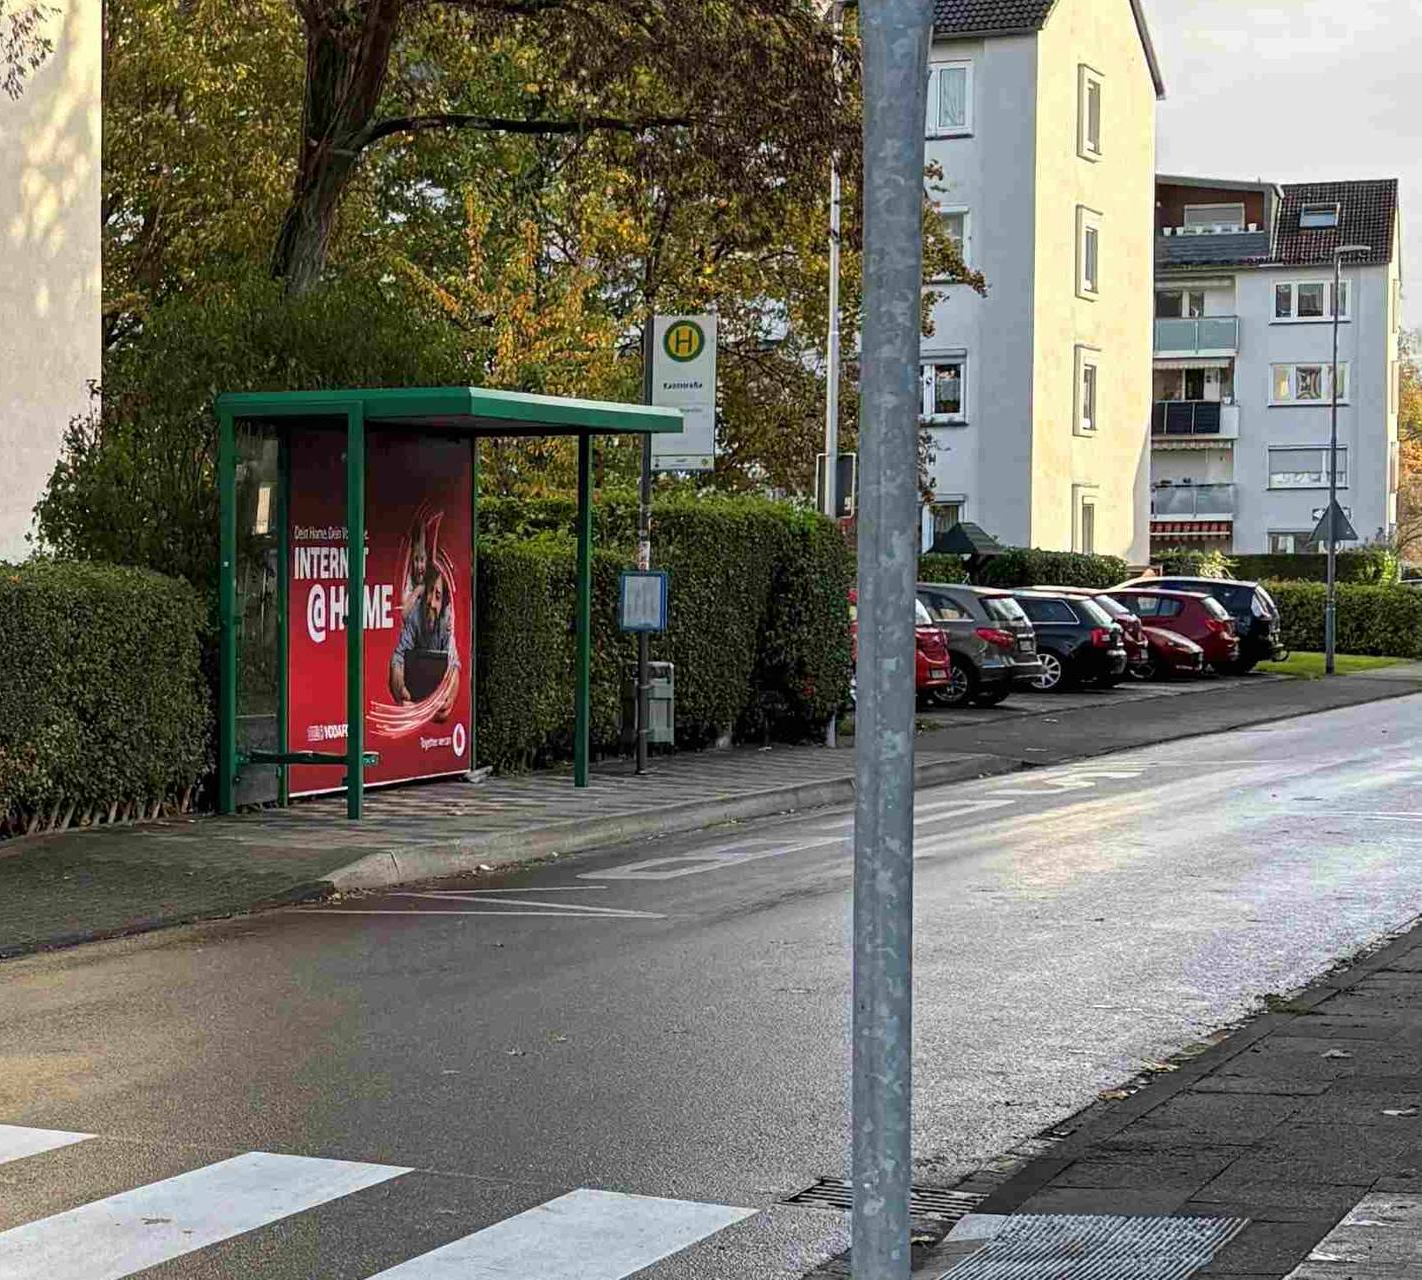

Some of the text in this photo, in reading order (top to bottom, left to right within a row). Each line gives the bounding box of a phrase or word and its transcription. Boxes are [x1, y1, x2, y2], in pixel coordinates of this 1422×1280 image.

[676, 330, 692, 353] H
[294, 547, 368, 580] INTERNT
[307, 583, 393, 643] @HME
